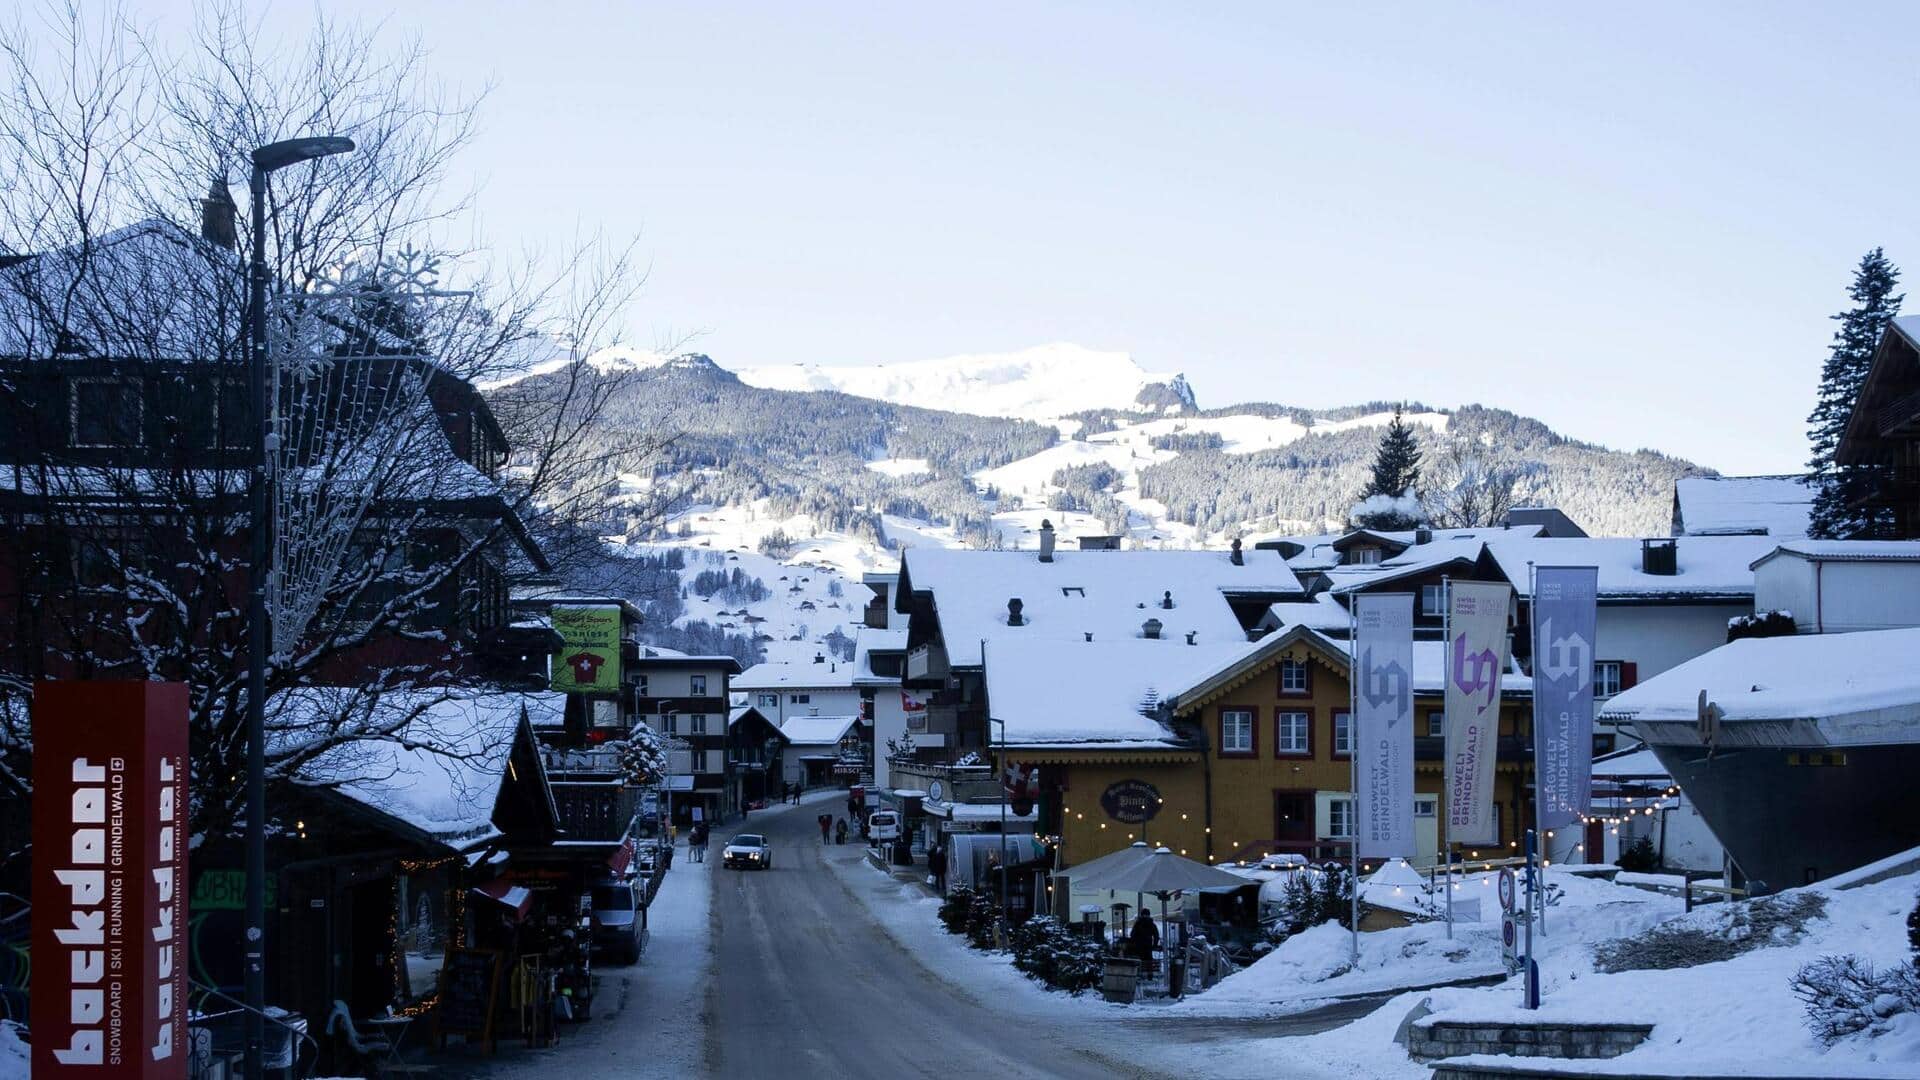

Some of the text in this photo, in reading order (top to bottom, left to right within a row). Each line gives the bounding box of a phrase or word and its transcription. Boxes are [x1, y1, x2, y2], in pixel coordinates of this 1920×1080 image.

[1371, 767, 1379, 841] BERGWELT
[1380, 739, 1391, 841] GRINDELWALD
[1452, 753, 1465, 825] BERGWELT
[1461, 725, 1477, 826] GRINDELWALD
[1546, 738, 1558, 813] BERGWELT
[1558, 711, 1569, 813] GRINDELWALD
[52, 757, 106, 1065] backdoor
[110, 774, 124, 1065] SNOWBOARD SKI RUNNING GRINDELWALD
[152, 757, 175, 1062] backdoor
